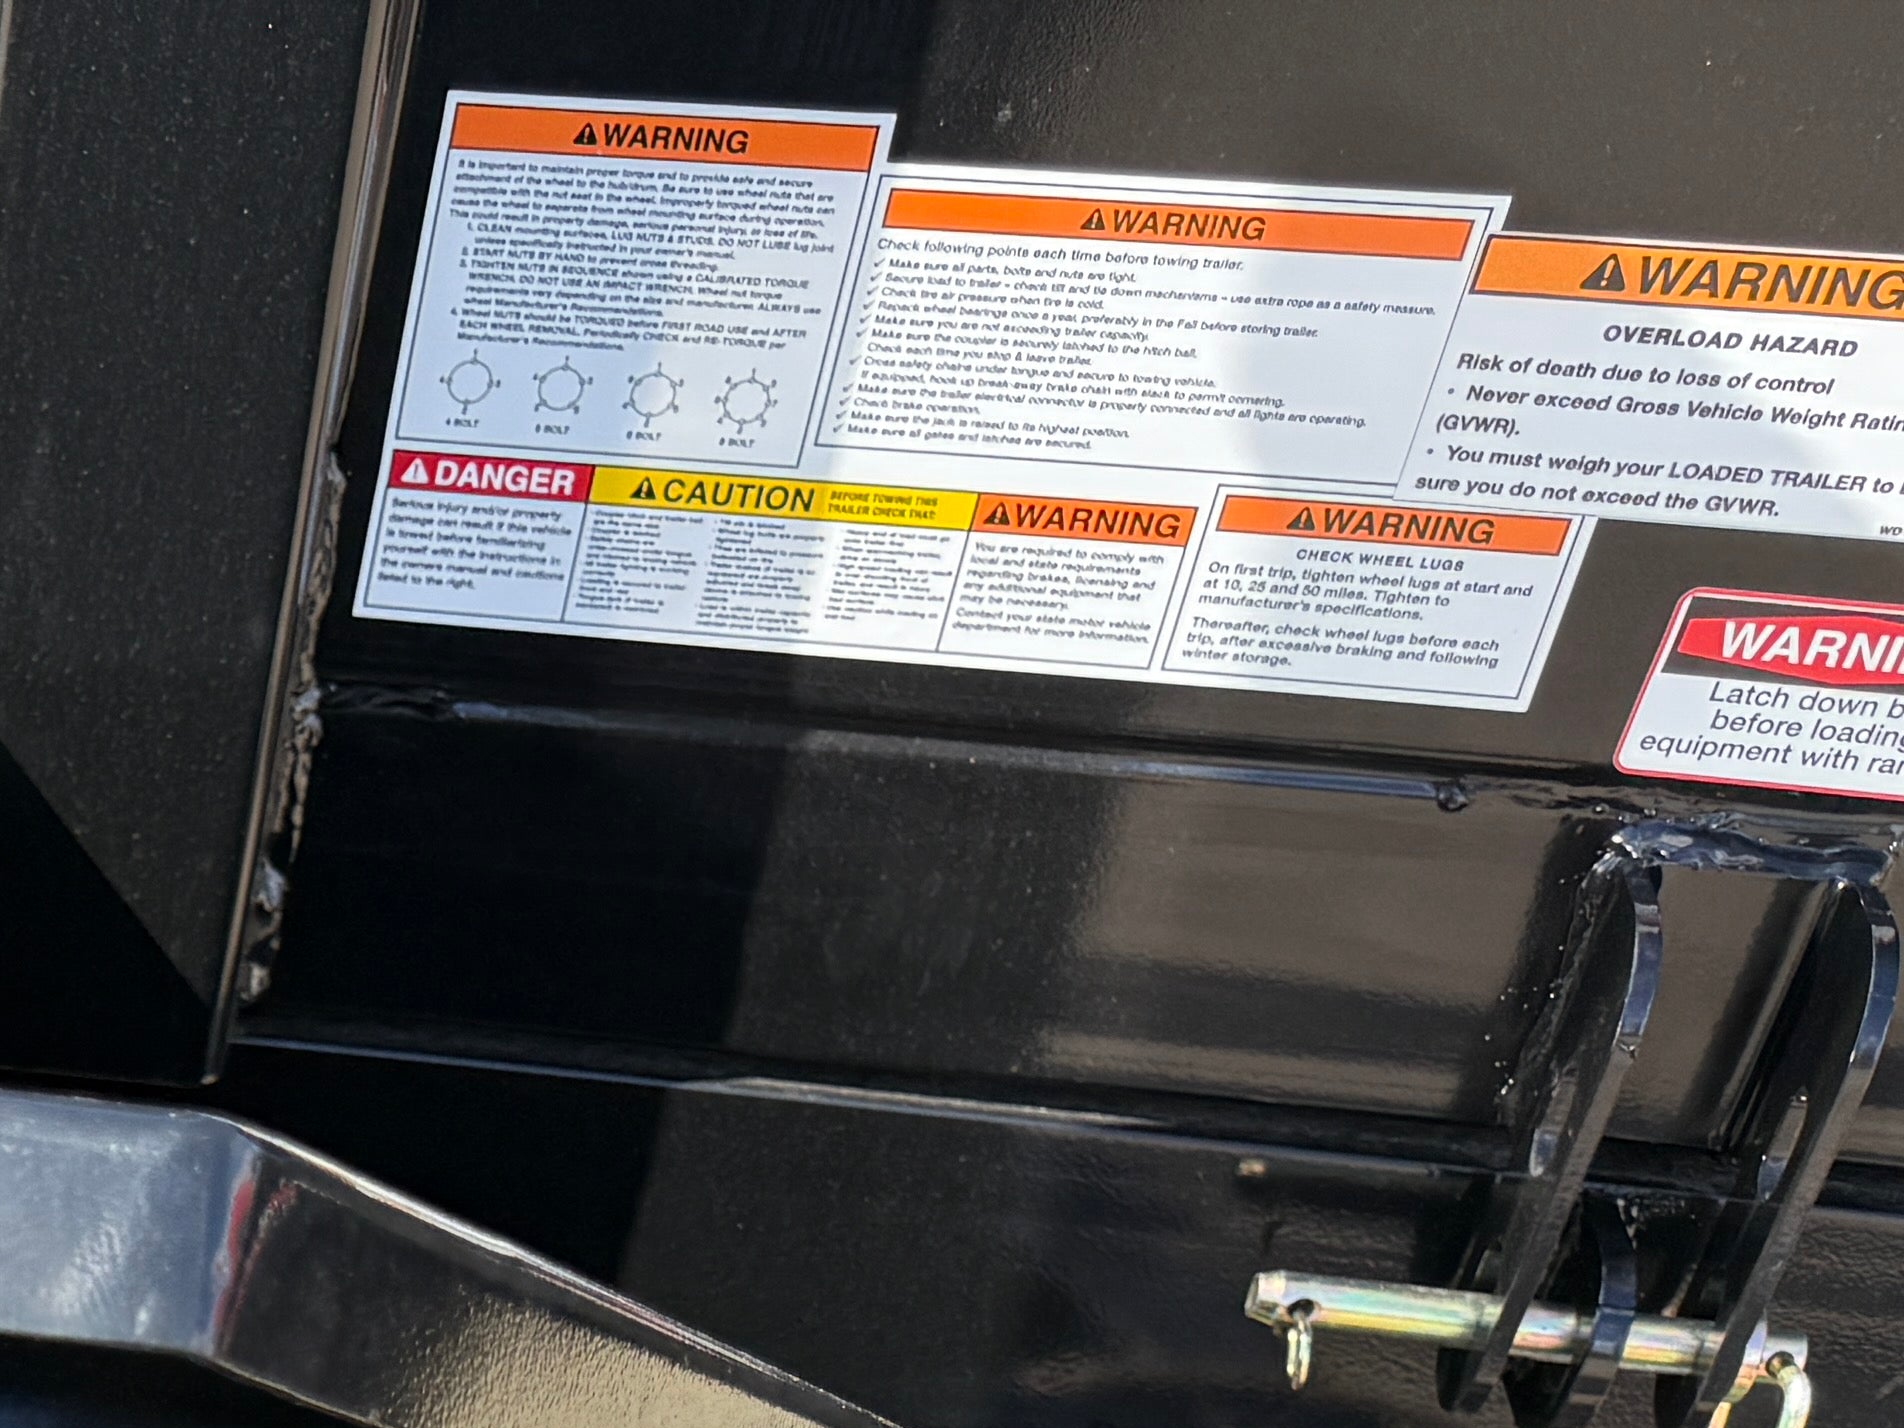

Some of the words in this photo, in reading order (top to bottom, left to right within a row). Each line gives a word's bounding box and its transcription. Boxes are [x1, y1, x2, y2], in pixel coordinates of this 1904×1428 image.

[604, 123, 749, 155] WARNING
[1114, 209, 1266, 241] WARNING
[877, 238, 919, 251] Check
[924, 240, 984, 258] following
[986, 245, 1029, 258] points
[1033, 248, 1067, 261] each
[1071, 249, 1102, 263] time
[1105, 251, 1149, 265] before
[1153, 254, 1199, 271] towing
[1202, 258, 1243, 271] trailer.
[1639, 255, 1904, 310] WARNING
[1603, 324, 1743, 350] OVERLOAD
[1749, 333, 1859, 357] HAZARD
[1456, 353, 1505, 372] Risk
[1508, 357, 1534, 374] of
[1535, 358, 1597, 379] death
[1601, 364, 1643, 382] due
[1648, 367, 1671, 384] to
[1675, 368, 1722, 388] loss
[1726, 372, 1753, 389] of
[1754, 377, 1836, 395] control
[1466, 384, 1531, 405] Never
[1533, 393, 1613, 411] exceed
[1616, 396, 1680, 416] Gross
[1688, 400, 1764, 422] Vehicle
[1771, 406, 1846, 430] Weight
[1436, 413, 1520, 439] (GVWR).
[434, 460, 576, 496] DANGER
[1447, 444, 1485, 463] You
[1488, 452, 1543, 468] must
[1548, 455, 1611, 476] weigh
[1612, 461, 1665, 478] your
[1667, 461, 1764, 484] LOADED
[1771, 469, 1868, 493] TRAILER
[1872, 477, 1895, 494] to
[663, 478, 815, 513] CAUTION
[1414, 477, 1461, 492] sure
[1463, 480, 1504, 497] you
[1508, 481, 1536, 498] do
[1541, 486, 1578, 502] not
[1581, 490, 1661, 508] exceed
[1664, 492, 1699, 510] the
[1704, 495, 1779, 517] GVWR.
[1016, 503, 1181, 539] WARNING
[1324, 507, 1495, 545] WARNING
[1296, 548, 1354, 564] CHECK
[1359, 553, 1414, 569] WHEEL
[1419, 557, 1465, 572] LUGS
[1203, 578, 1219, 589] at
[1224, 579, 1243, 593] 10,
[1247, 580, 1267, 593] 25
[1269, 583, 1300, 596] and
[1301, 584, 1321, 597] 50
[1323, 587, 1368, 601] miles.
[1374, 589, 1431, 606] Tighten
[1434, 595, 1451, 607] to
[1208, 561, 1230, 575] On
[1234, 563, 1264, 577] first
[1267, 566, 1297, 582] trip,
[1301, 568, 1355, 584] tighten
[1359, 573, 1405, 588] wheel
[1407, 575, 1441, 592] lugs
[1443, 580, 1461, 592] at
[1463, 581, 1501, 595] start
[1503, 584, 1534, 597] and
[1198, 595, 1311, 612] manufacturer's
[1314, 603, 1424, 621] specifications.
[1186, 632, 1215, 646] trip,
[1219, 635, 1256, 647] after
[1258, 639, 1332, 654] excessive
[1335, 643, 1394, 662] braking
[1396, 649, 1427, 662] and
[1429, 650, 1500, 670] following
[1193, 616, 1270, 636] Thereafter,
[1274, 623, 1321, 638] check
[1325, 627, 1371, 641] wheel
[1372, 630, 1405, 646] lugs
[1408, 632, 1458, 648] before
[1461, 639, 1500, 652] each
[1182, 648, 1229, 660] winter
[1232, 651, 1292, 668] storage.
[1709, 681, 1790, 709] Latch
[1798, 691, 1879, 718] down
[1710, 709, 1803, 737] before
[1639, 734, 1792, 764] equipment
[1801, 747, 1859, 771] with
